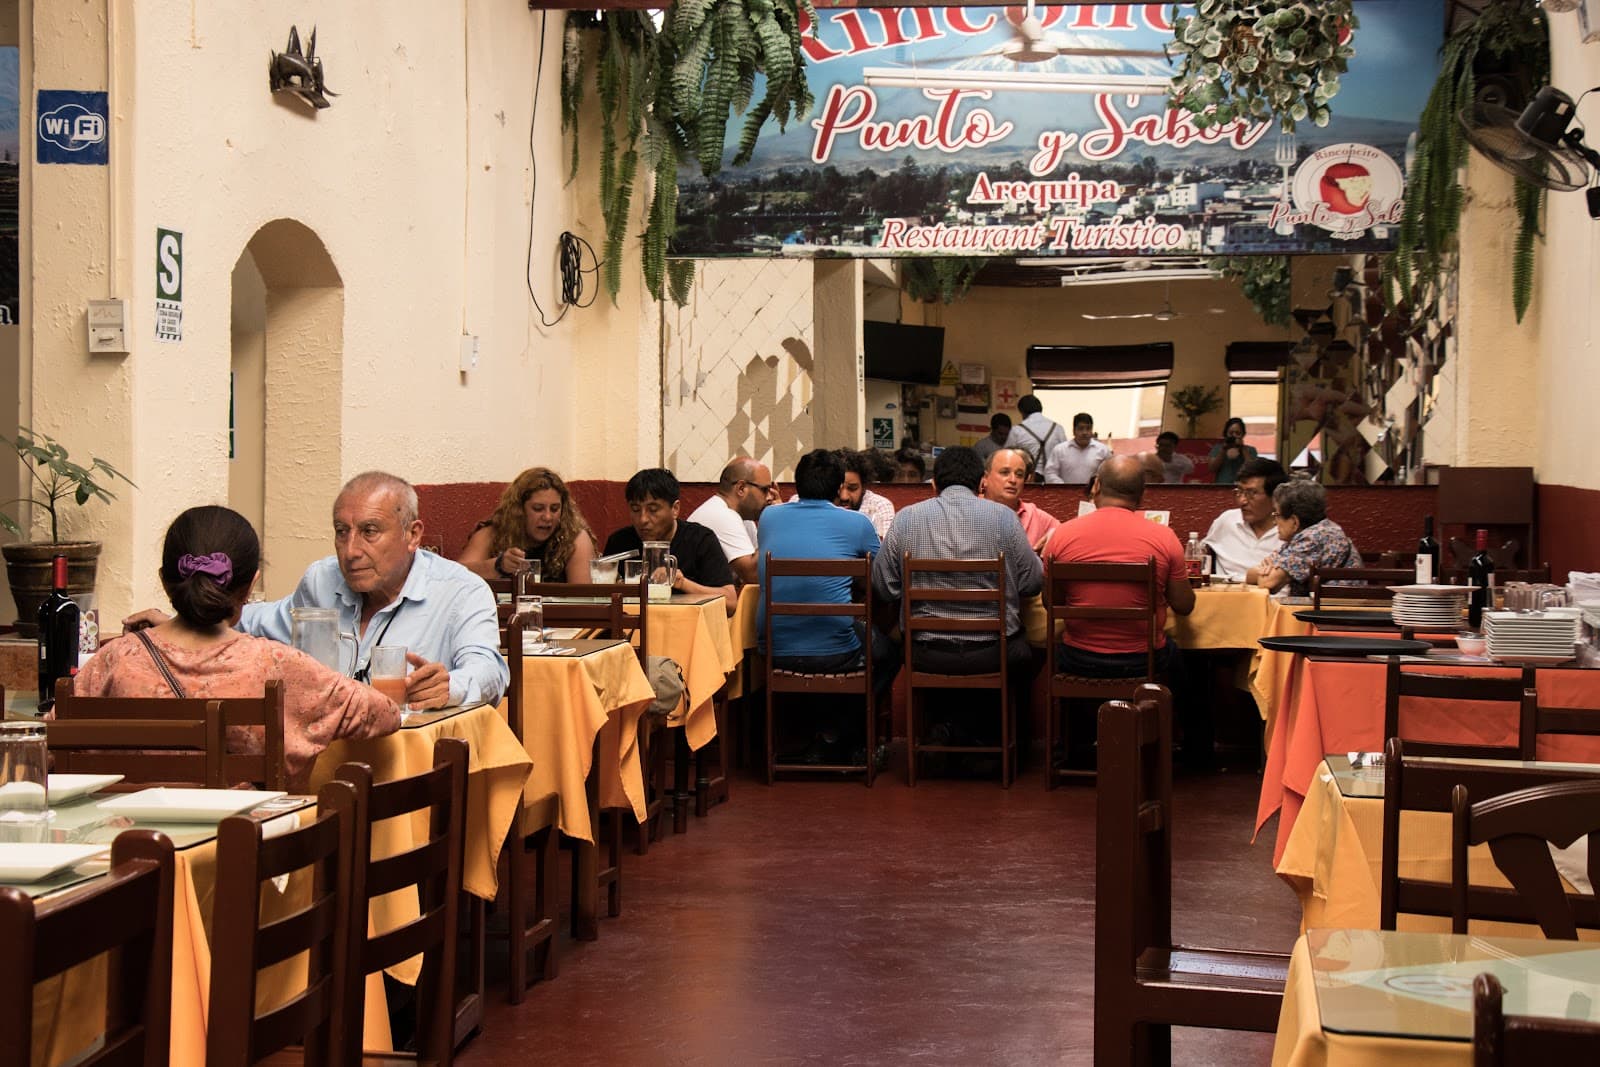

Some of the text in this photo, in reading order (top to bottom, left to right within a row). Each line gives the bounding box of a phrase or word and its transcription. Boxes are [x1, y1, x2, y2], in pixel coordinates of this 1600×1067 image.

[812, 85, 1272, 175] Punto y Sabor
[1314, 147, 1379, 161] Rinconcito
[969, 172, 1119, 209] Arequipa
[879, 216, 1183, 250] Restaurant Turístico
[158, 234, 180, 295] S
